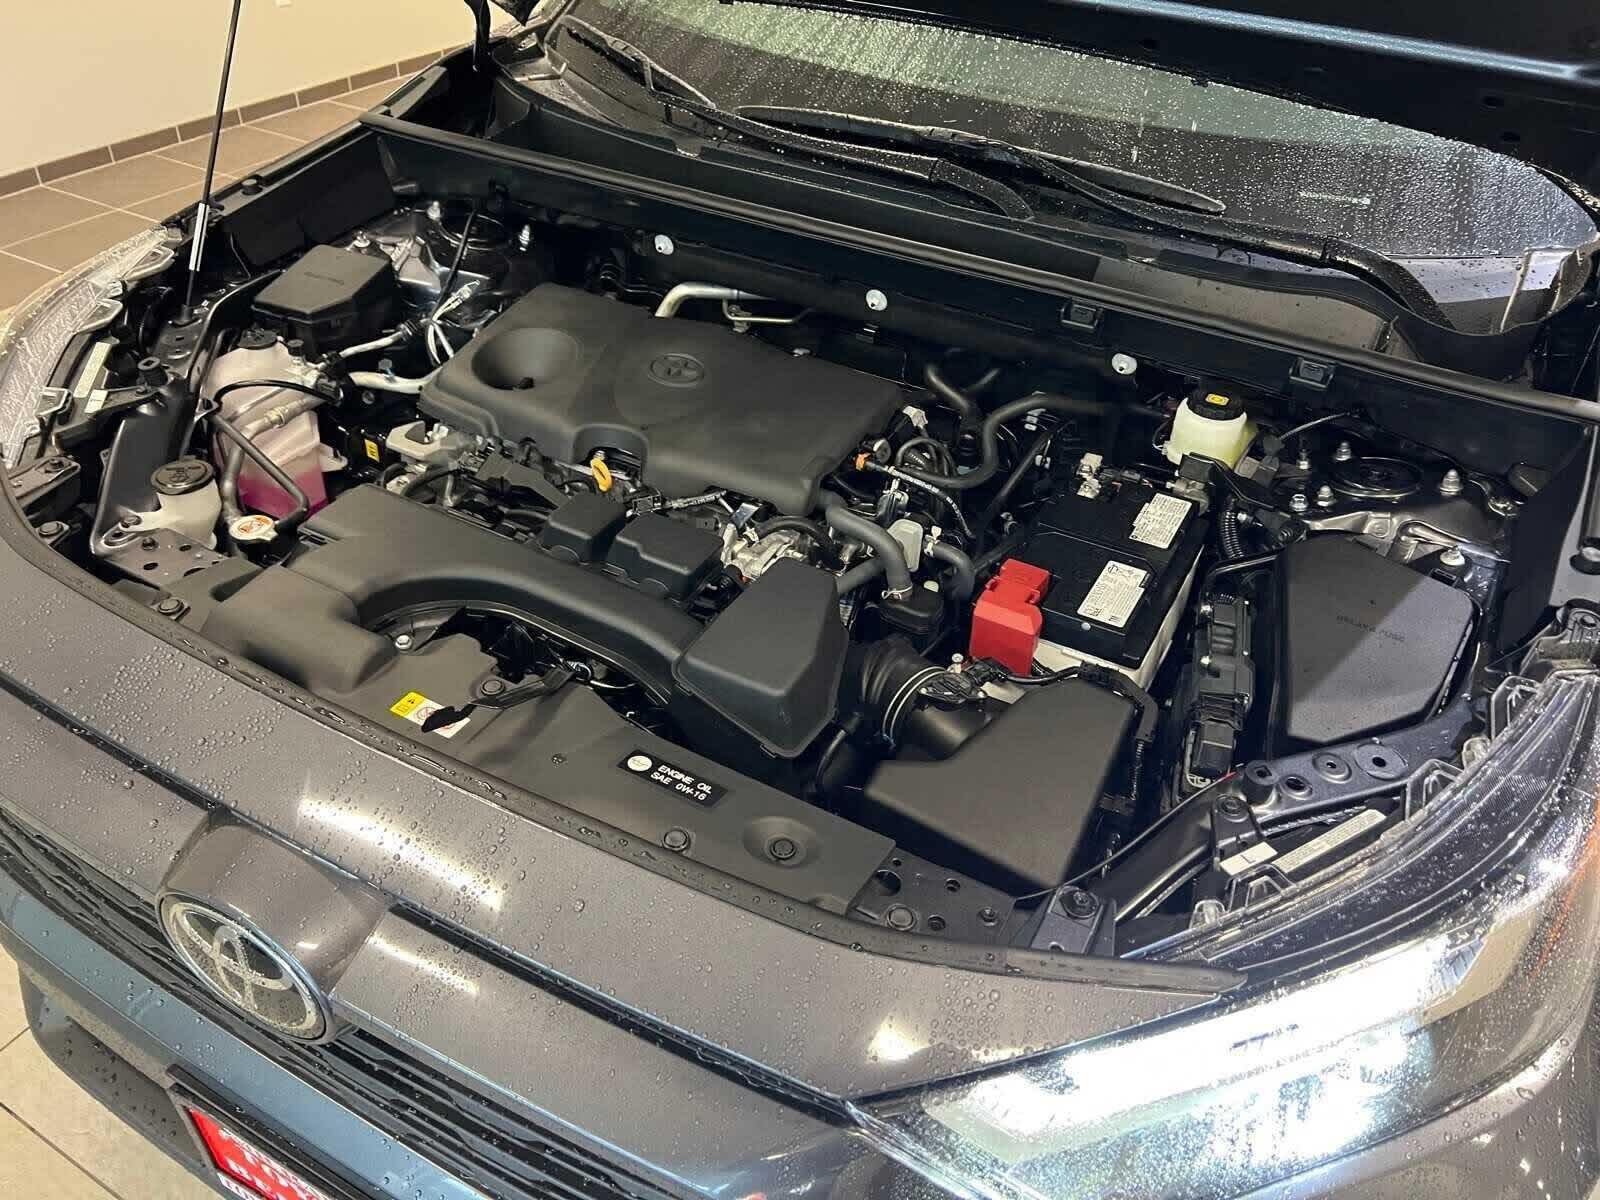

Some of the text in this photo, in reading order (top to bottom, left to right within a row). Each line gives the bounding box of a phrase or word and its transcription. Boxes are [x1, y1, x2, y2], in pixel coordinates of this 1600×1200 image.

[650, 771, 673, 785] SAE
[657, 764, 713, 794] ENGINE OIL
